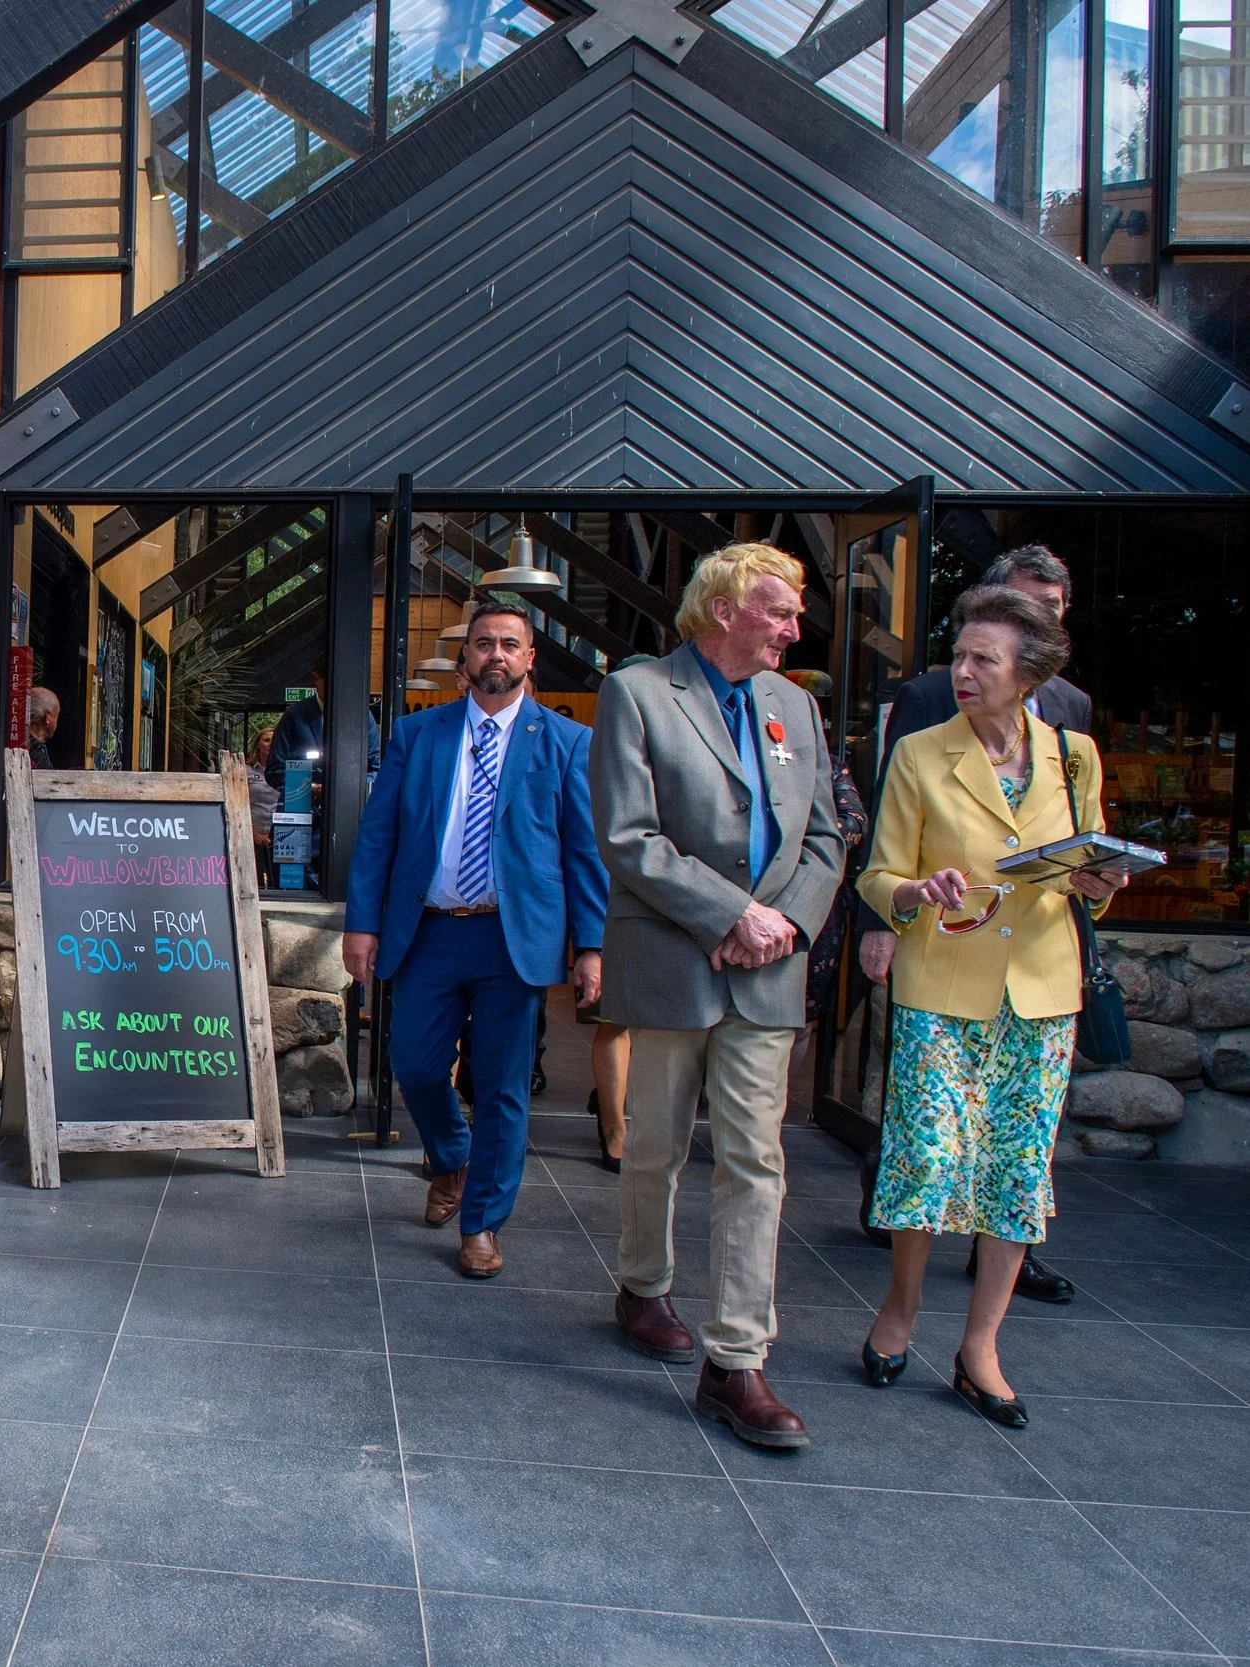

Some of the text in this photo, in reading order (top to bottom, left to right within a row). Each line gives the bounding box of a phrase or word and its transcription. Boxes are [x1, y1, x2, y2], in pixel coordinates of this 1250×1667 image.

[10, 655, 20, 741] FIRE ALARM
[68, 812, 189, 840] WELCOME
[116, 843, 139, 854] TO
[40, 855, 229, 885] WILLOWBANK
[80, 910, 207, 935] OPEN FROM
[62, 1010, 235, 1039] ASK ABOUT OUR
[75, 1042, 238, 1077] ENCOUNTERS!
